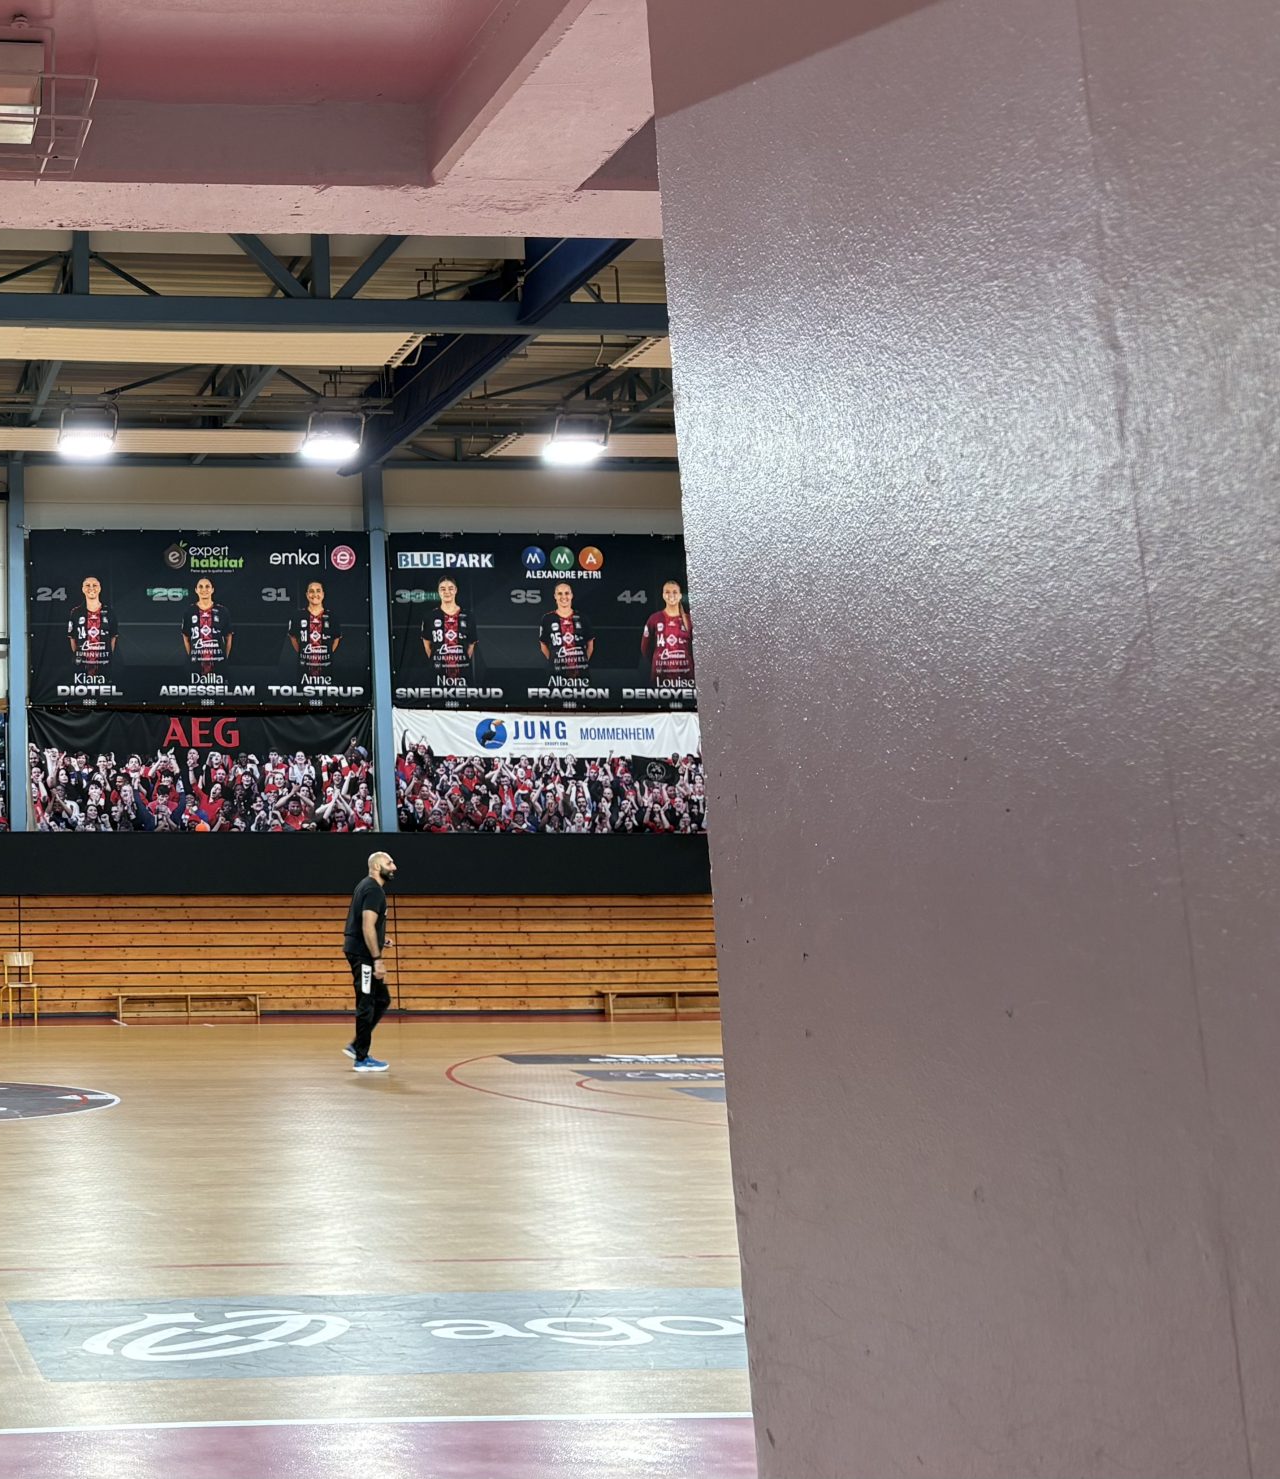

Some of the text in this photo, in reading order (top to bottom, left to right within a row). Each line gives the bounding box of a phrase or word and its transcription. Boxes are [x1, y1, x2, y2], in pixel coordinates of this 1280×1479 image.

[189, 545, 229, 558] expert
[269, 548, 320, 565] emka
[191, 556, 244, 568] habitat
[526, 570, 602, 579] ALEXANDRE PETRI
[36, 587, 68, 601] 24
[261, 588, 290, 602] 31
[510, 590, 542, 604] 35
[616, 590, 648, 604] 44
[74, 673, 106, 684] Kiara
[191, 672, 224, 684] Dalila
[301, 674, 332, 684] Anne
[437, 675, 466, 686] Nora
[548, 675, 590, 687] Albane
[656, 676, 695, 688] Louise
[57, 686, 123, 696] DIOTEL
[159, 686, 255, 696] ABDESSELAM
[268, 686, 364, 697] TOLSTRUP
[396, 688, 504, 699] SNEDKERUD
[527, 688, 610, 700] FRACHON
[162, 718, 240, 748] AEG
[513, 720, 655, 740] JUNG MOMMENHEIM
